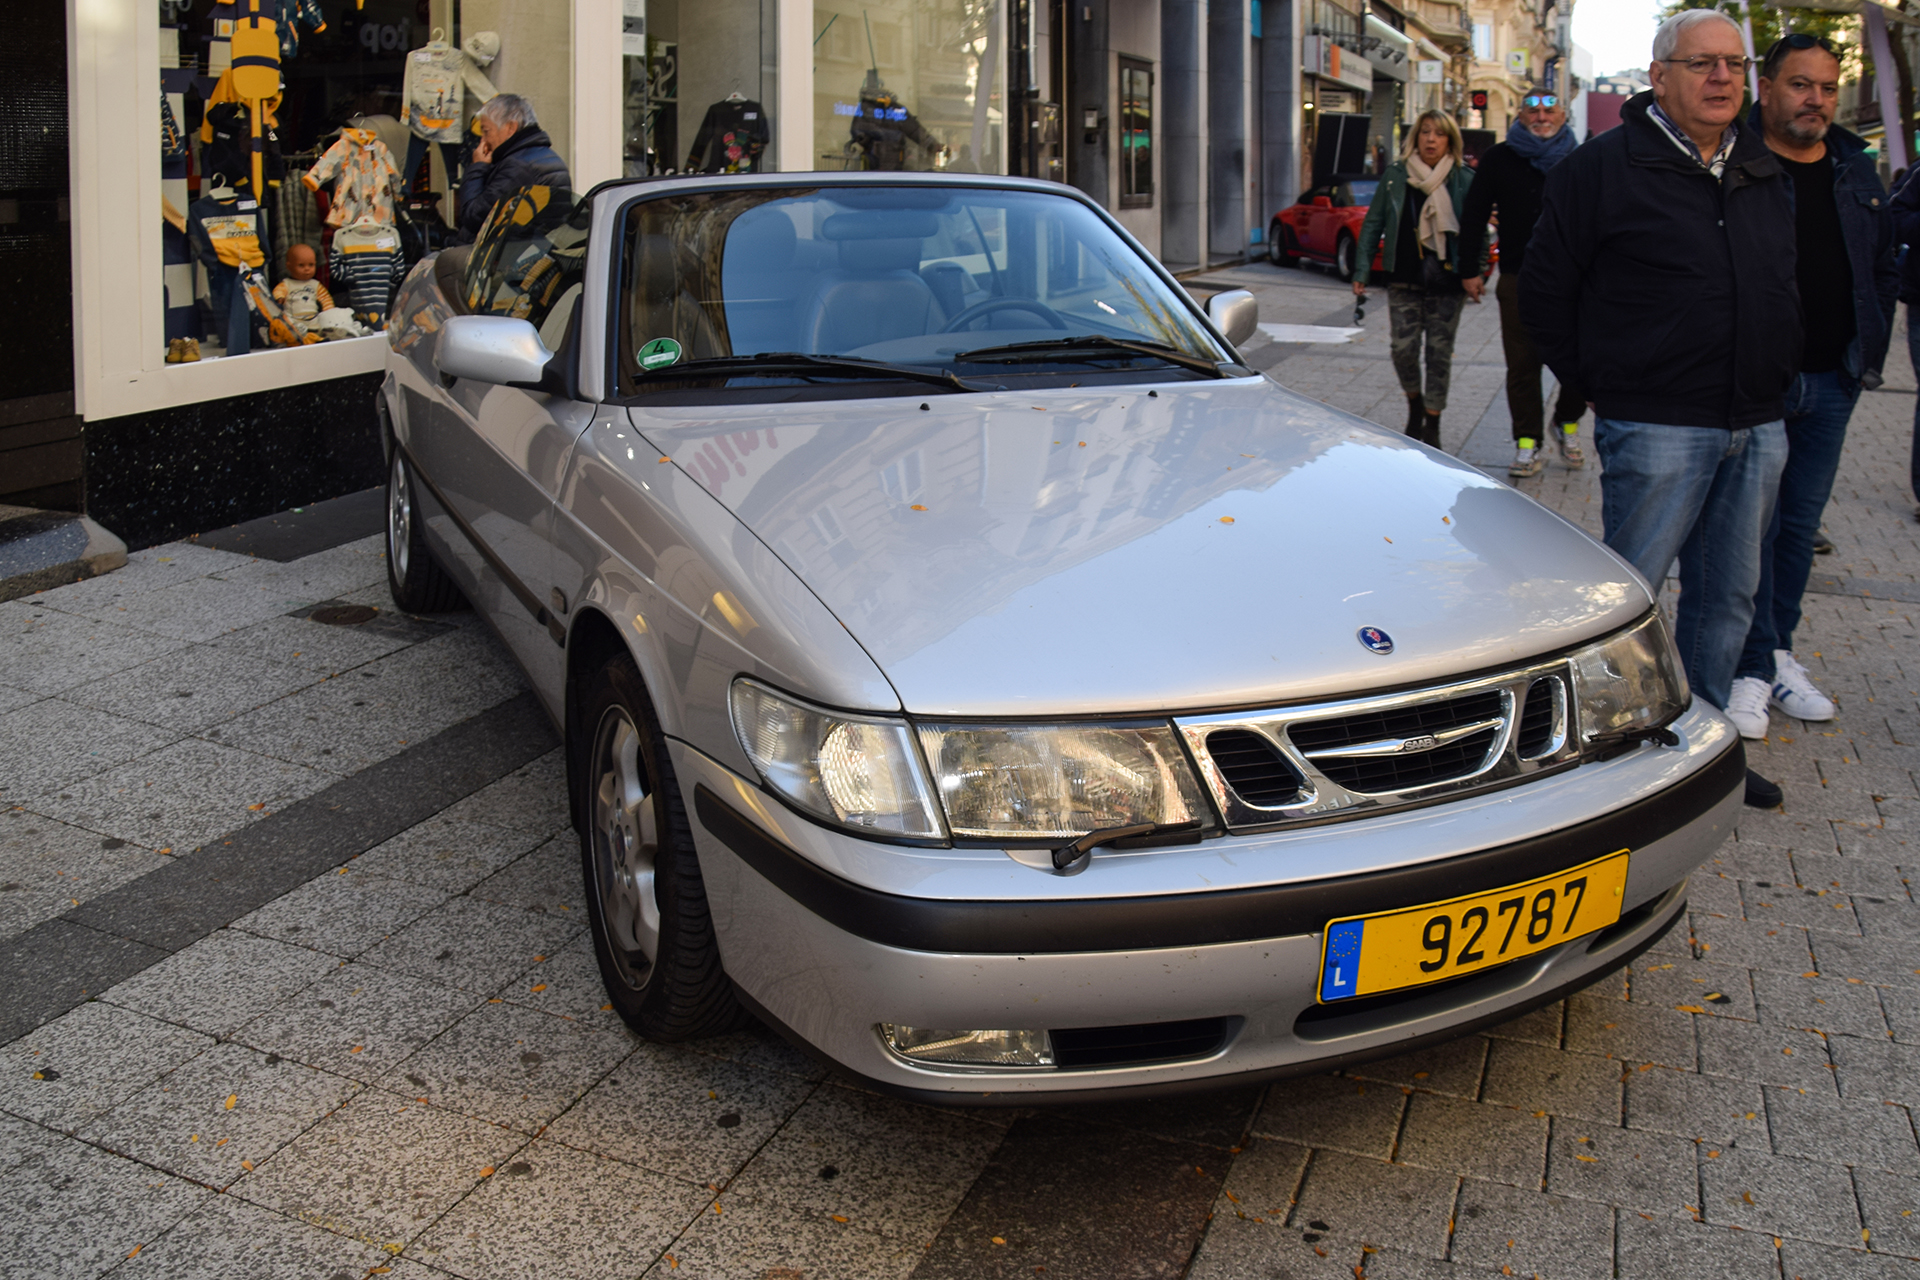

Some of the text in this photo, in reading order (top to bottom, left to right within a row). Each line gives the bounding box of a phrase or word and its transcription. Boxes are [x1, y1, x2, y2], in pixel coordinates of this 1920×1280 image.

[653, 340, 665, 353] 4
[1404, 738, 1433, 751] SAAB
[1419, 876, 1588, 973] 92787
[1333, 967, 1346, 987] L
